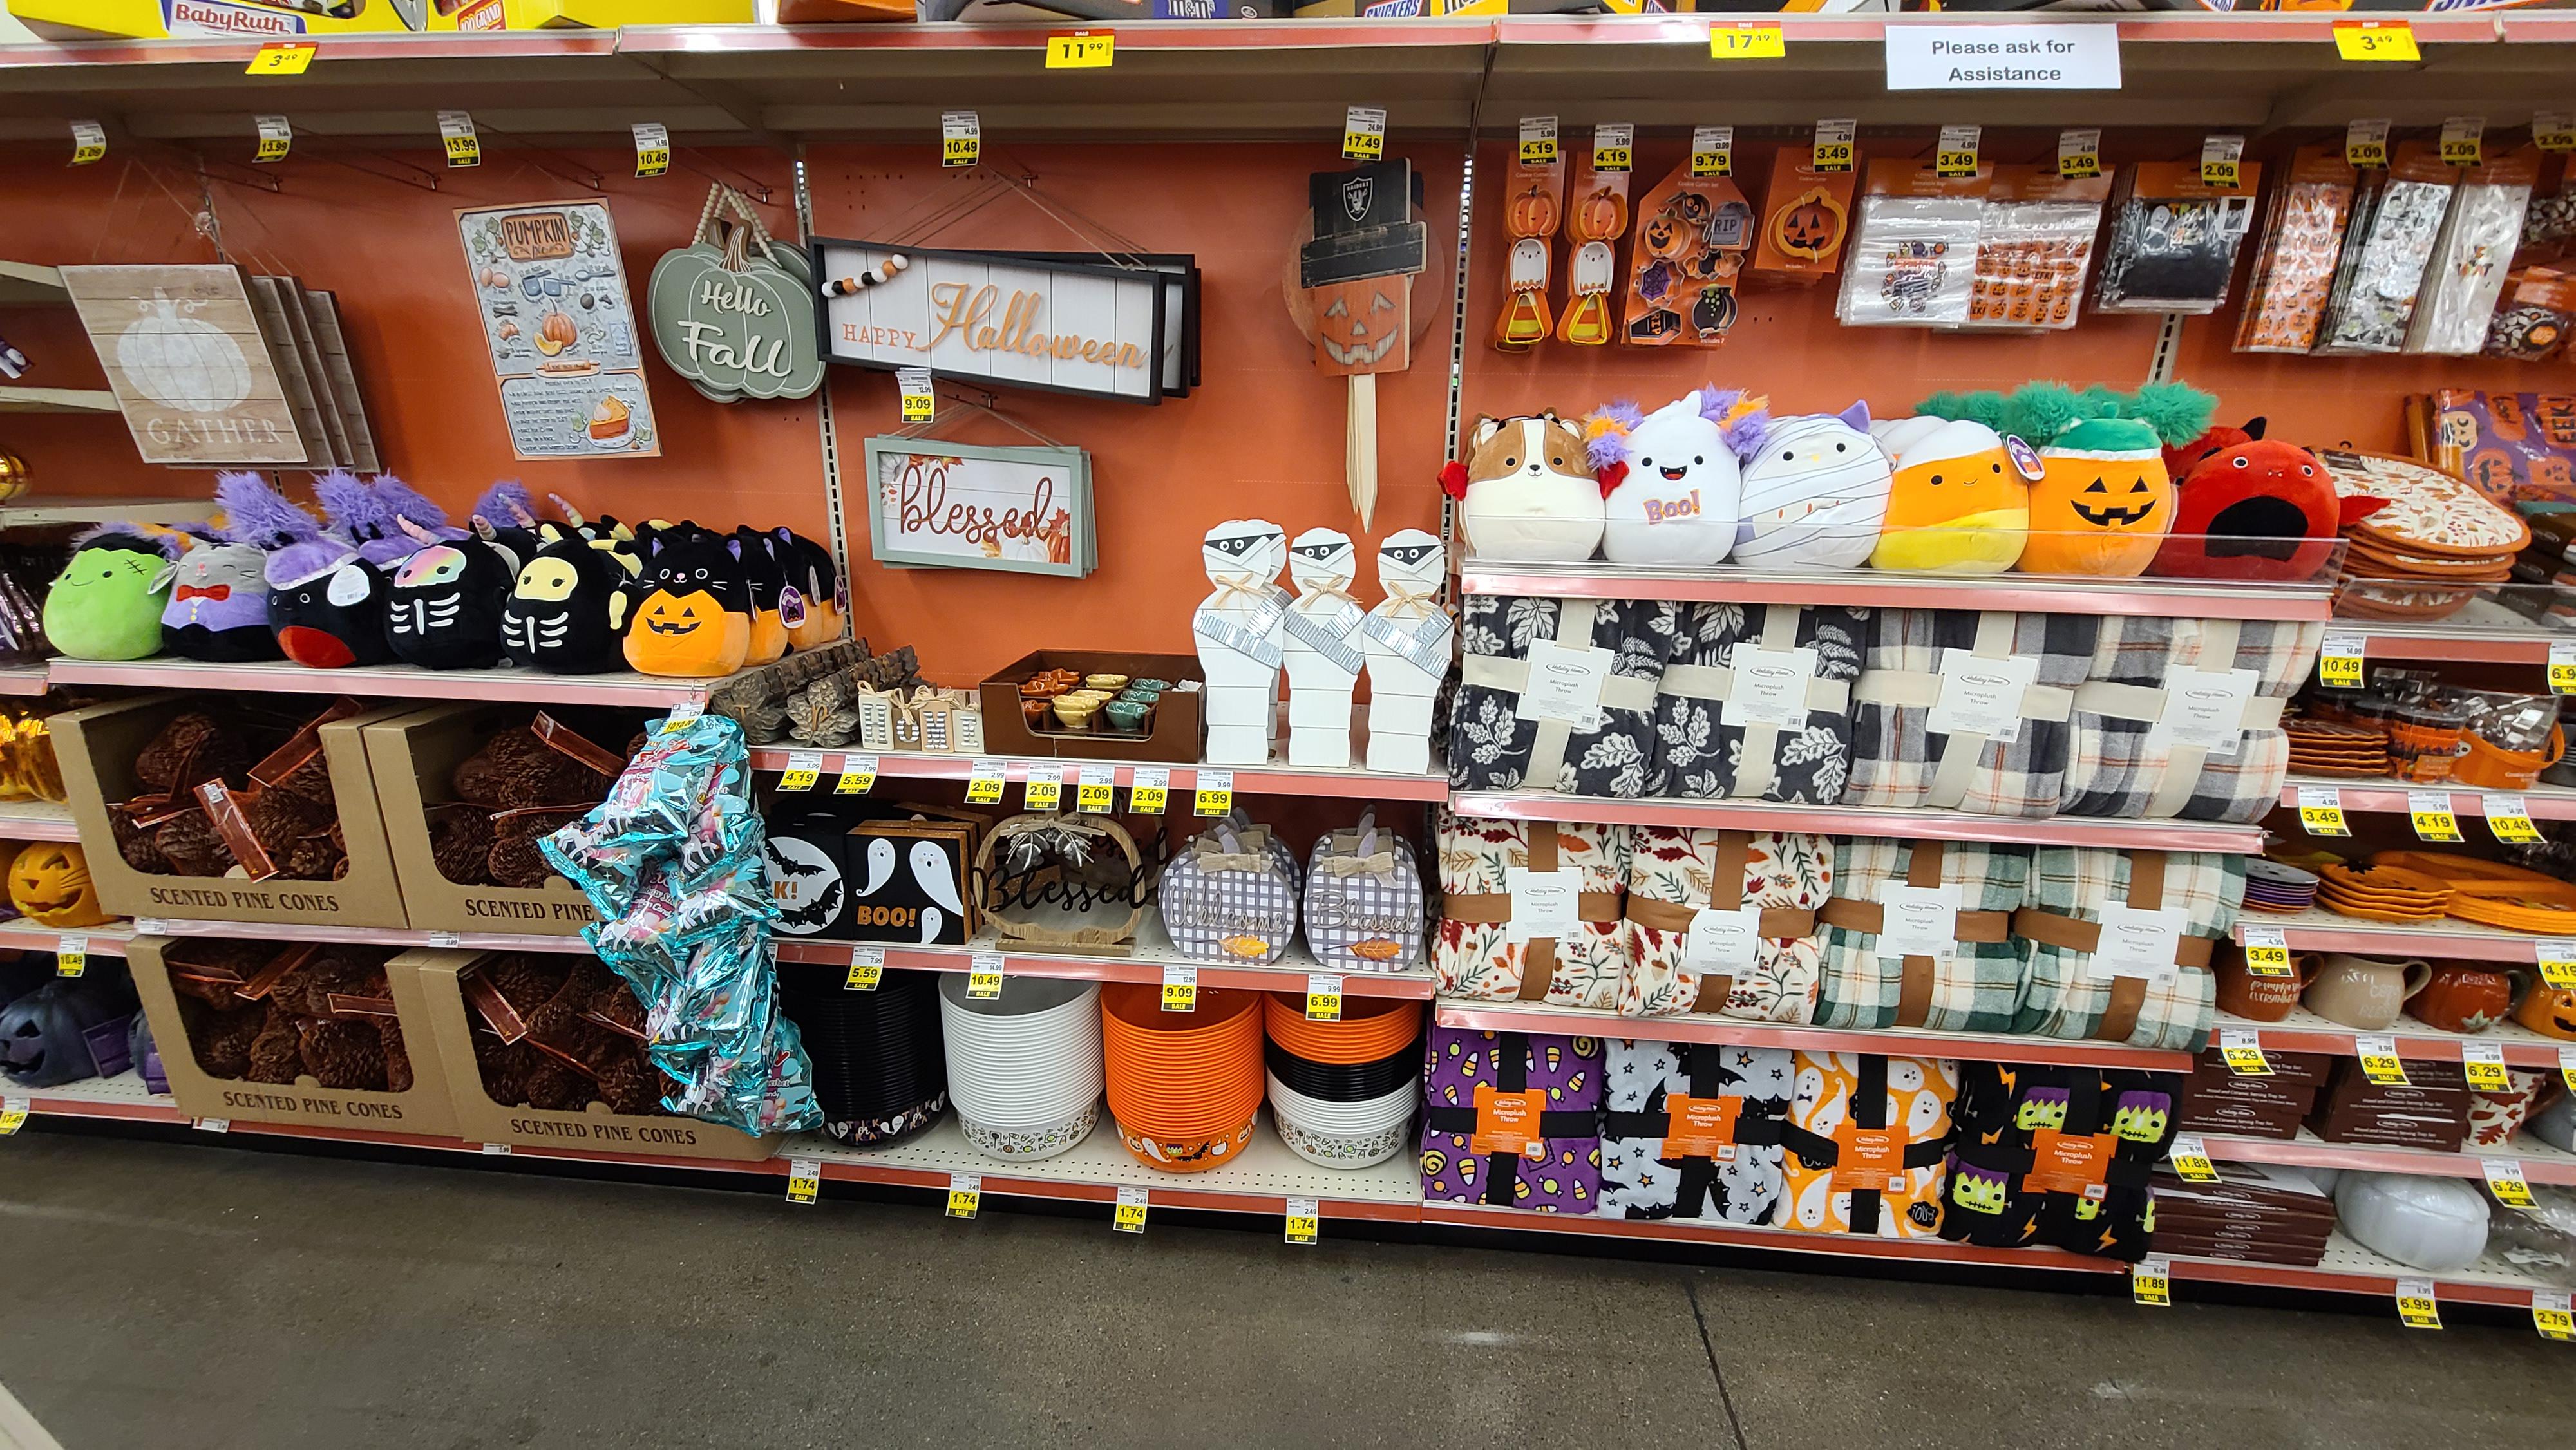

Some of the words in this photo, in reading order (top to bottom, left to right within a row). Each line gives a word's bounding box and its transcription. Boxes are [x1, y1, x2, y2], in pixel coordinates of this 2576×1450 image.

[1366, 0, 1420, 17] SNICKERS
[476, 3, 502, 29] GRAND
[1931, 40, 1999, 55] Please
[2005, 39, 2041, 53] ask
[2045, 39, 2076, 53] for
[1949, 66, 2061, 82] Assistance
[261, 142, 288, 153] 13.99
[448, 139, 477, 153] 13.99
[947, 142, 978, 154] 10.49
[1347, 135, 1380, 149] 17.49
[1522, 143, 1553, 155] 4.19
[1817, 146, 1848, 159] 3.49
[2351, 146, 2382, 158] 2.09
[2445, 144, 2476, 156] 2.09
[640, 152, 667, 165] 10.49
[1596, 151, 1627, 162] 4.19
[1696, 156, 1727, 166] 9.79
[1940, 155, 1973, 166] 3.49
[2063, 157, 2094, 169] 3.49
[2205, 164, 2234, 177] 2.09
[1347, 181, 1369, 192] RAIDERS
[505, 218, 567, 245] PUMPKIN
[1714, 219, 1737, 232] RIP
[700, 279, 773, 317] Hello
[842, 323, 916, 349] HAPPY
[915, 282, 1148, 370] Halloween
[1651, 312, 1662, 335] RIP
[677, 319, 792, 377] Fall
[905, 398, 931, 410] 9.09
[147, 418, 284, 444] GATHER
[900, 463, 1053, 544] blessed
[2323, 660, 2360, 673] 10.49
[2552, 668, 2576, 680] 6.9
[1549, 679, 1579, 688] Microplush
[1754, 683, 1785, 691] Microplush
[1964, 690, 1997, 699] Microplush
[786, 772, 814, 782] 4.19
[843, 776, 871, 785] 5.59
[972, 782, 1000, 793] 2.09
[1030, 786, 1057, 796] 2.09
[1082, 788, 1110, 799] 2.09
[1135, 791, 1163, 802] 2.09
[1199, 793, 1227, 804] 6.99
[2306, 811, 2339, 824] 3.49
[2417, 816, 2450, 827] 4.19
[2492, 820, 2531, 831] 10.49
[972, 862, 1157, 913] Blessed
[149, 887, 228, 907] SCENTED
[231, 891, 274, 909] PINE
[278, 893, 339, 912] CONES
[465, 899, 546, 919] SCENTED
[551, 903, 595, 921] PINE
[1167, 883, 1288, 933] Welcome
[1309, 890, 1419, 934] Blessed
[857, 905, 916, 928] BOO!
[60, 954, 82, 965] 10.49
[2250, 950, 2284, 962] 3.49
[851, 968, 878, 979] 5.59
[971, 975, 1000, 986] 10.49
[1166, 987, 1193, 998] 9.09
[1311, 996, 1338, 1007] 6.99
[2227, 1050, 2259, 1060] 6.29
[2363, 1057, 2396, 1068] 6.29
[2468, 1066, 2501, 1078] 6.29
[223, 1091, 298, 1111] SCENTED
[301, 1098, 341, 1115] PINE
[346, 1102, 403, 1120] CONES
[1493, 1108, 1527, 1117] Microplush
[1686, 1113, 1721, 1122] Microplush
[511, 1119, 587, 1138] SCENTED
[592, 1124, 633, 1141] PINE
[638, 1127, 697, 1145] CONES
[1855, 1145, 1891, 1154] Microplush
[2054, 1149, 2092, 1160] Microplush
[2061, 1156, 2083, 1165] Throw
[2174, 1156, 2209, 1169] 11.89
[793, 1179, 815, 1191] 1.74
[2492, 1181, 2524, 1192] 6.29
[953, 1194, 976, 1205] 1.74
[1120, 1208, 1144, 1219] 1.74
[1290, 1219, 1314, 1230] 1.74
[2135, 1277, 2165, 1290] 11.89
[2400, 1299, 2431, 1310] 6.99
[2537, 1313, 2568, 1326] 2.79
